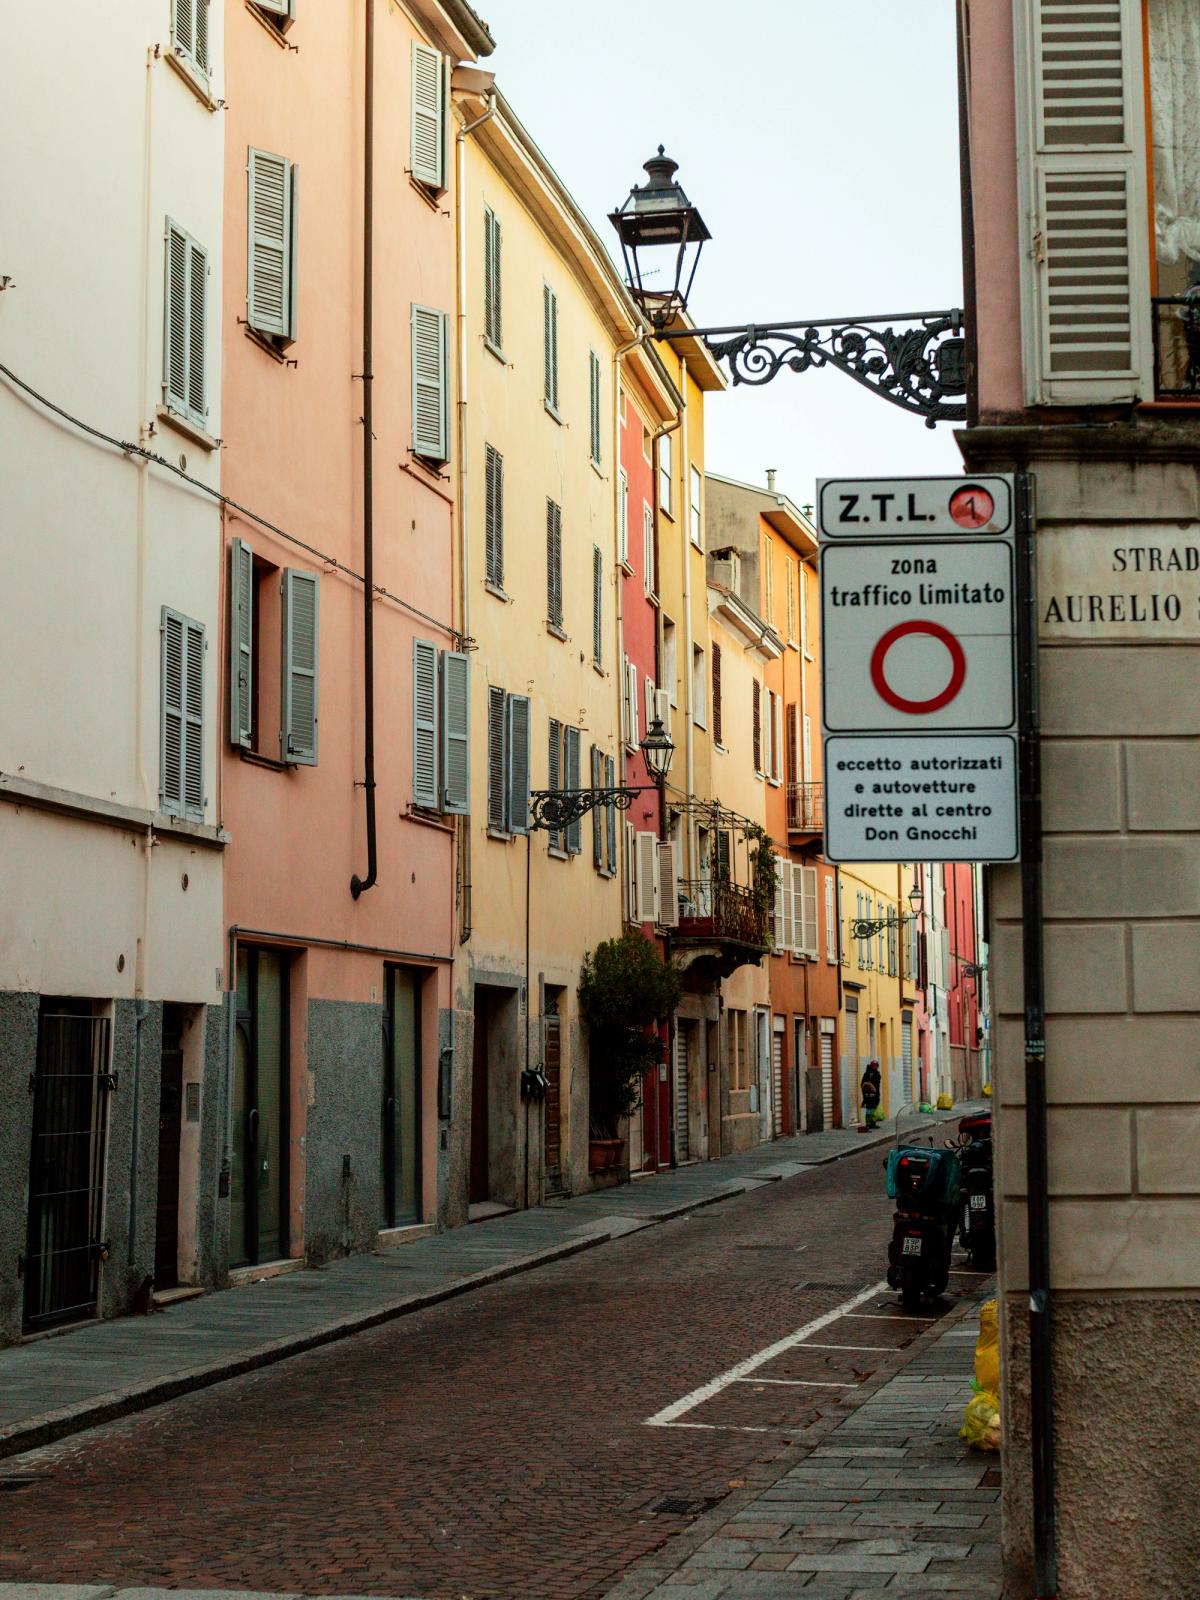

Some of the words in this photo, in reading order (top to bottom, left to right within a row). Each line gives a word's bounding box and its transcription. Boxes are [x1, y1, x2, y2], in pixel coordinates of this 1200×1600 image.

[839, 493, 936, 523] Z.T.L.
[964, 495, 977, 521] 1
[891, 558, 937, 575] zona
[1112, 547, 1200, 572] STRAD
[830, 584, 912, 607] traffico
[919, 582, 1005, 606] limitato
[1042, 594, 1181, 624] AURELIO
[836, 757, 902, 771] eccetto
[910, 756, 1002, 771] autorizzati
[854, 783, 865, 794] e
[872, 780, 976, 794] autovetture
[844, 804, 903, 818] dirette
[911, 803, 928, 817] al
[935, 803, 992, 817] centro
[865, 827, 899, 841] Don
[906, 826, 977, 841] Gnocchi
